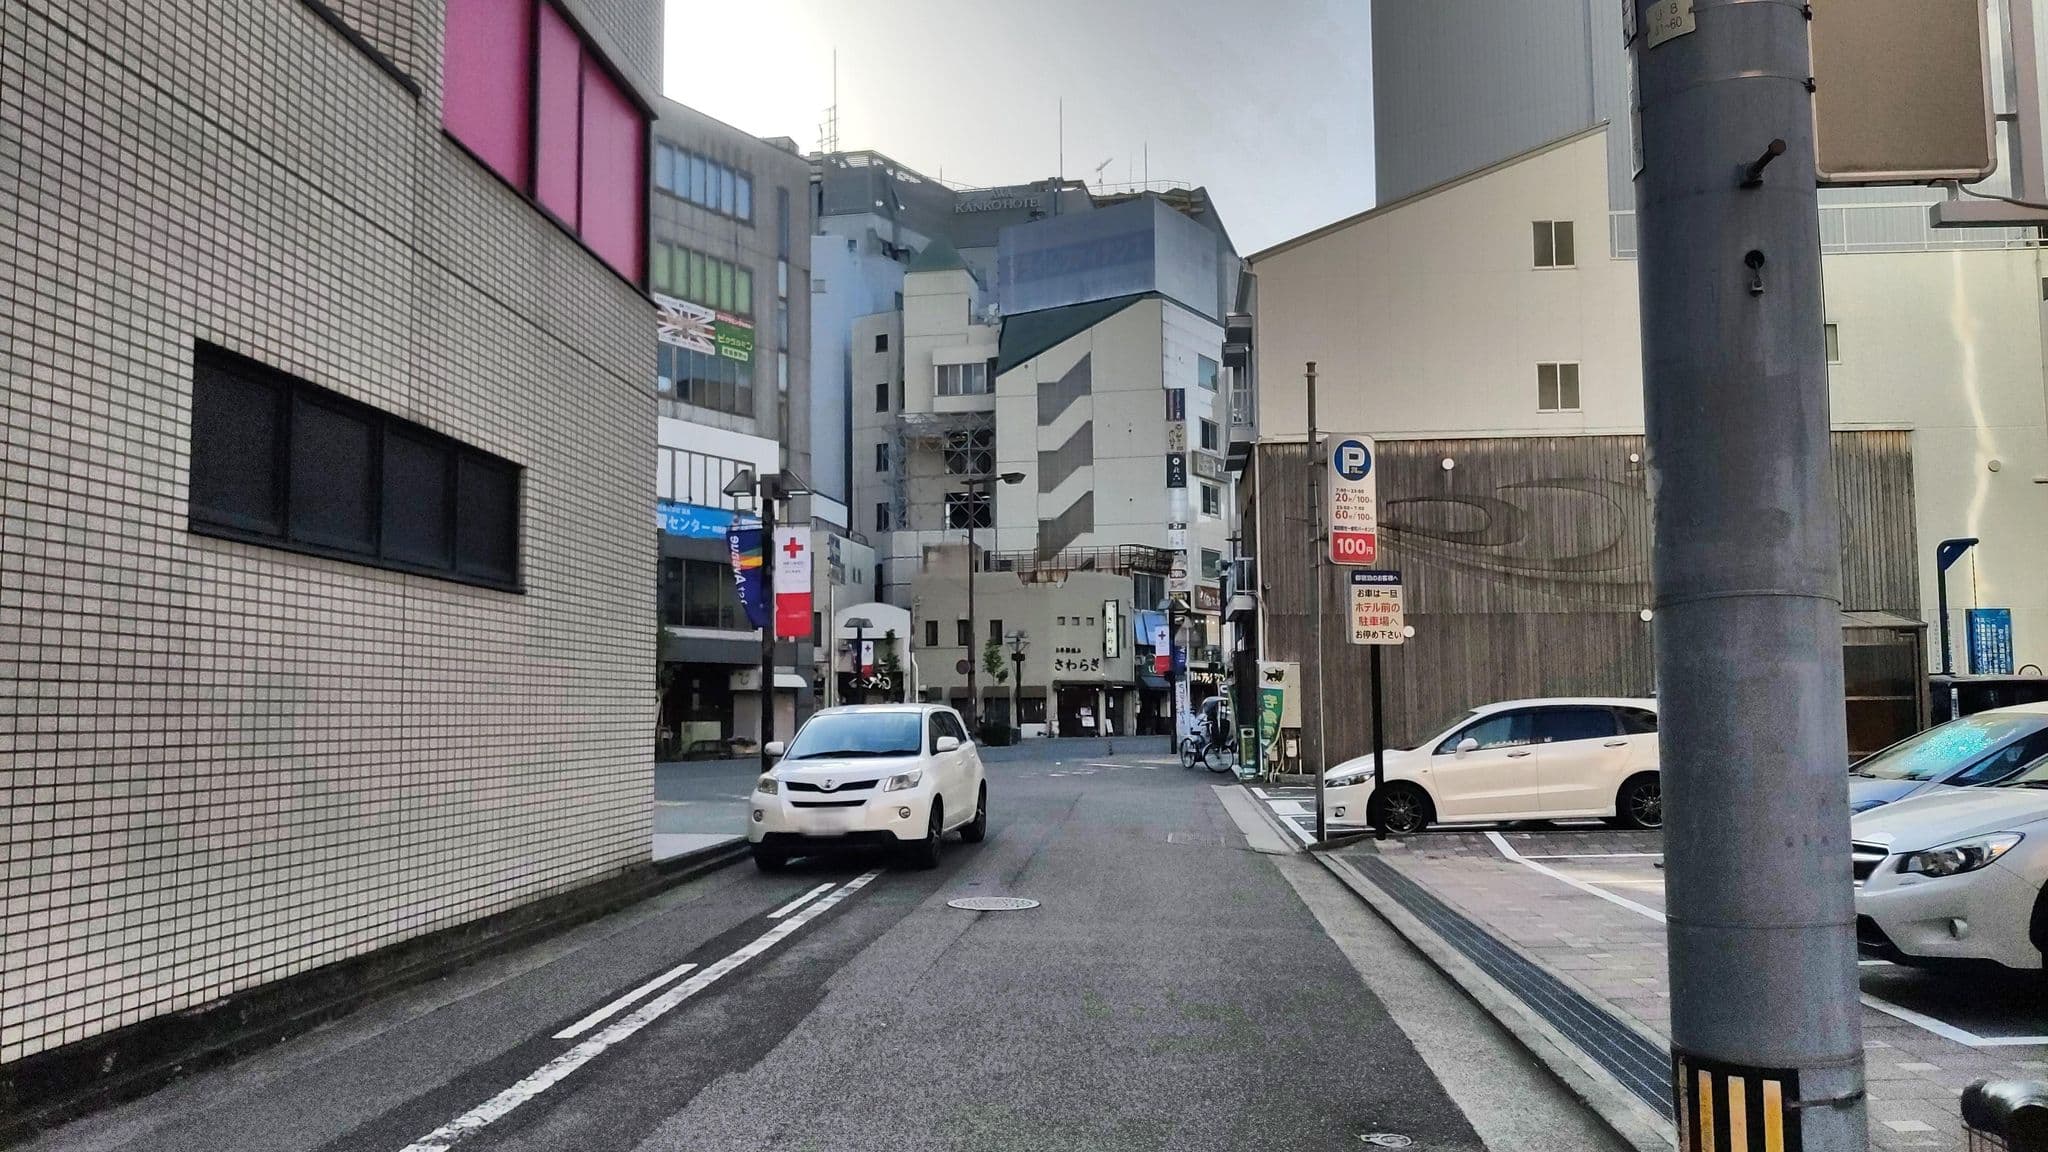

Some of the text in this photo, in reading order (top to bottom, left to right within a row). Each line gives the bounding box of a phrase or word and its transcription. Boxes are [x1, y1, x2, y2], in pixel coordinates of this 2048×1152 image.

[1342, 446, 1365, 474] P
[1337, 538, 1374, 556] 100円
[1355, 602, 1401, 613] ホテル前の
[1359, 616, 1399, 627] 駐車場へ
[1356, 630, 1402, 640] お停め下さい
[1055, 658, 1100, 672] さわらぎ
